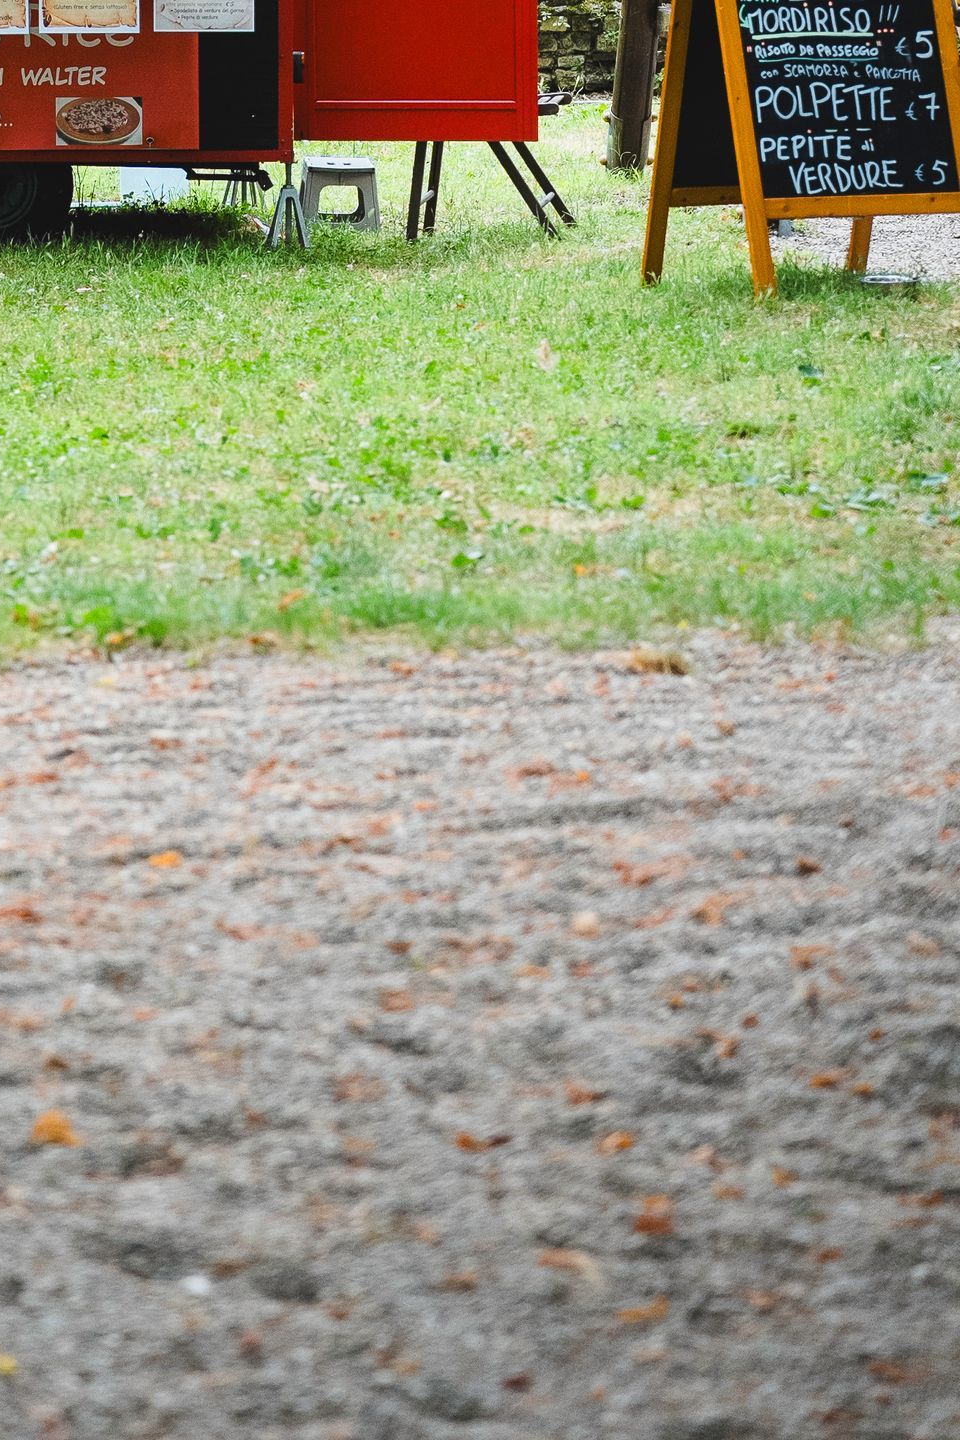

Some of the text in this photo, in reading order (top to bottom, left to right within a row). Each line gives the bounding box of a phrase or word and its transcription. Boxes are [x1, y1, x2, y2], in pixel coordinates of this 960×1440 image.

[915, 30, 934, 59] 5
[21, 66, 107, 87] WALTER
[755, 82, 940, 124] POLPETTE € 7
[760, 129, 874, 162] PEPITE di
[789, 160, 949, 195] VERDURE € 5
